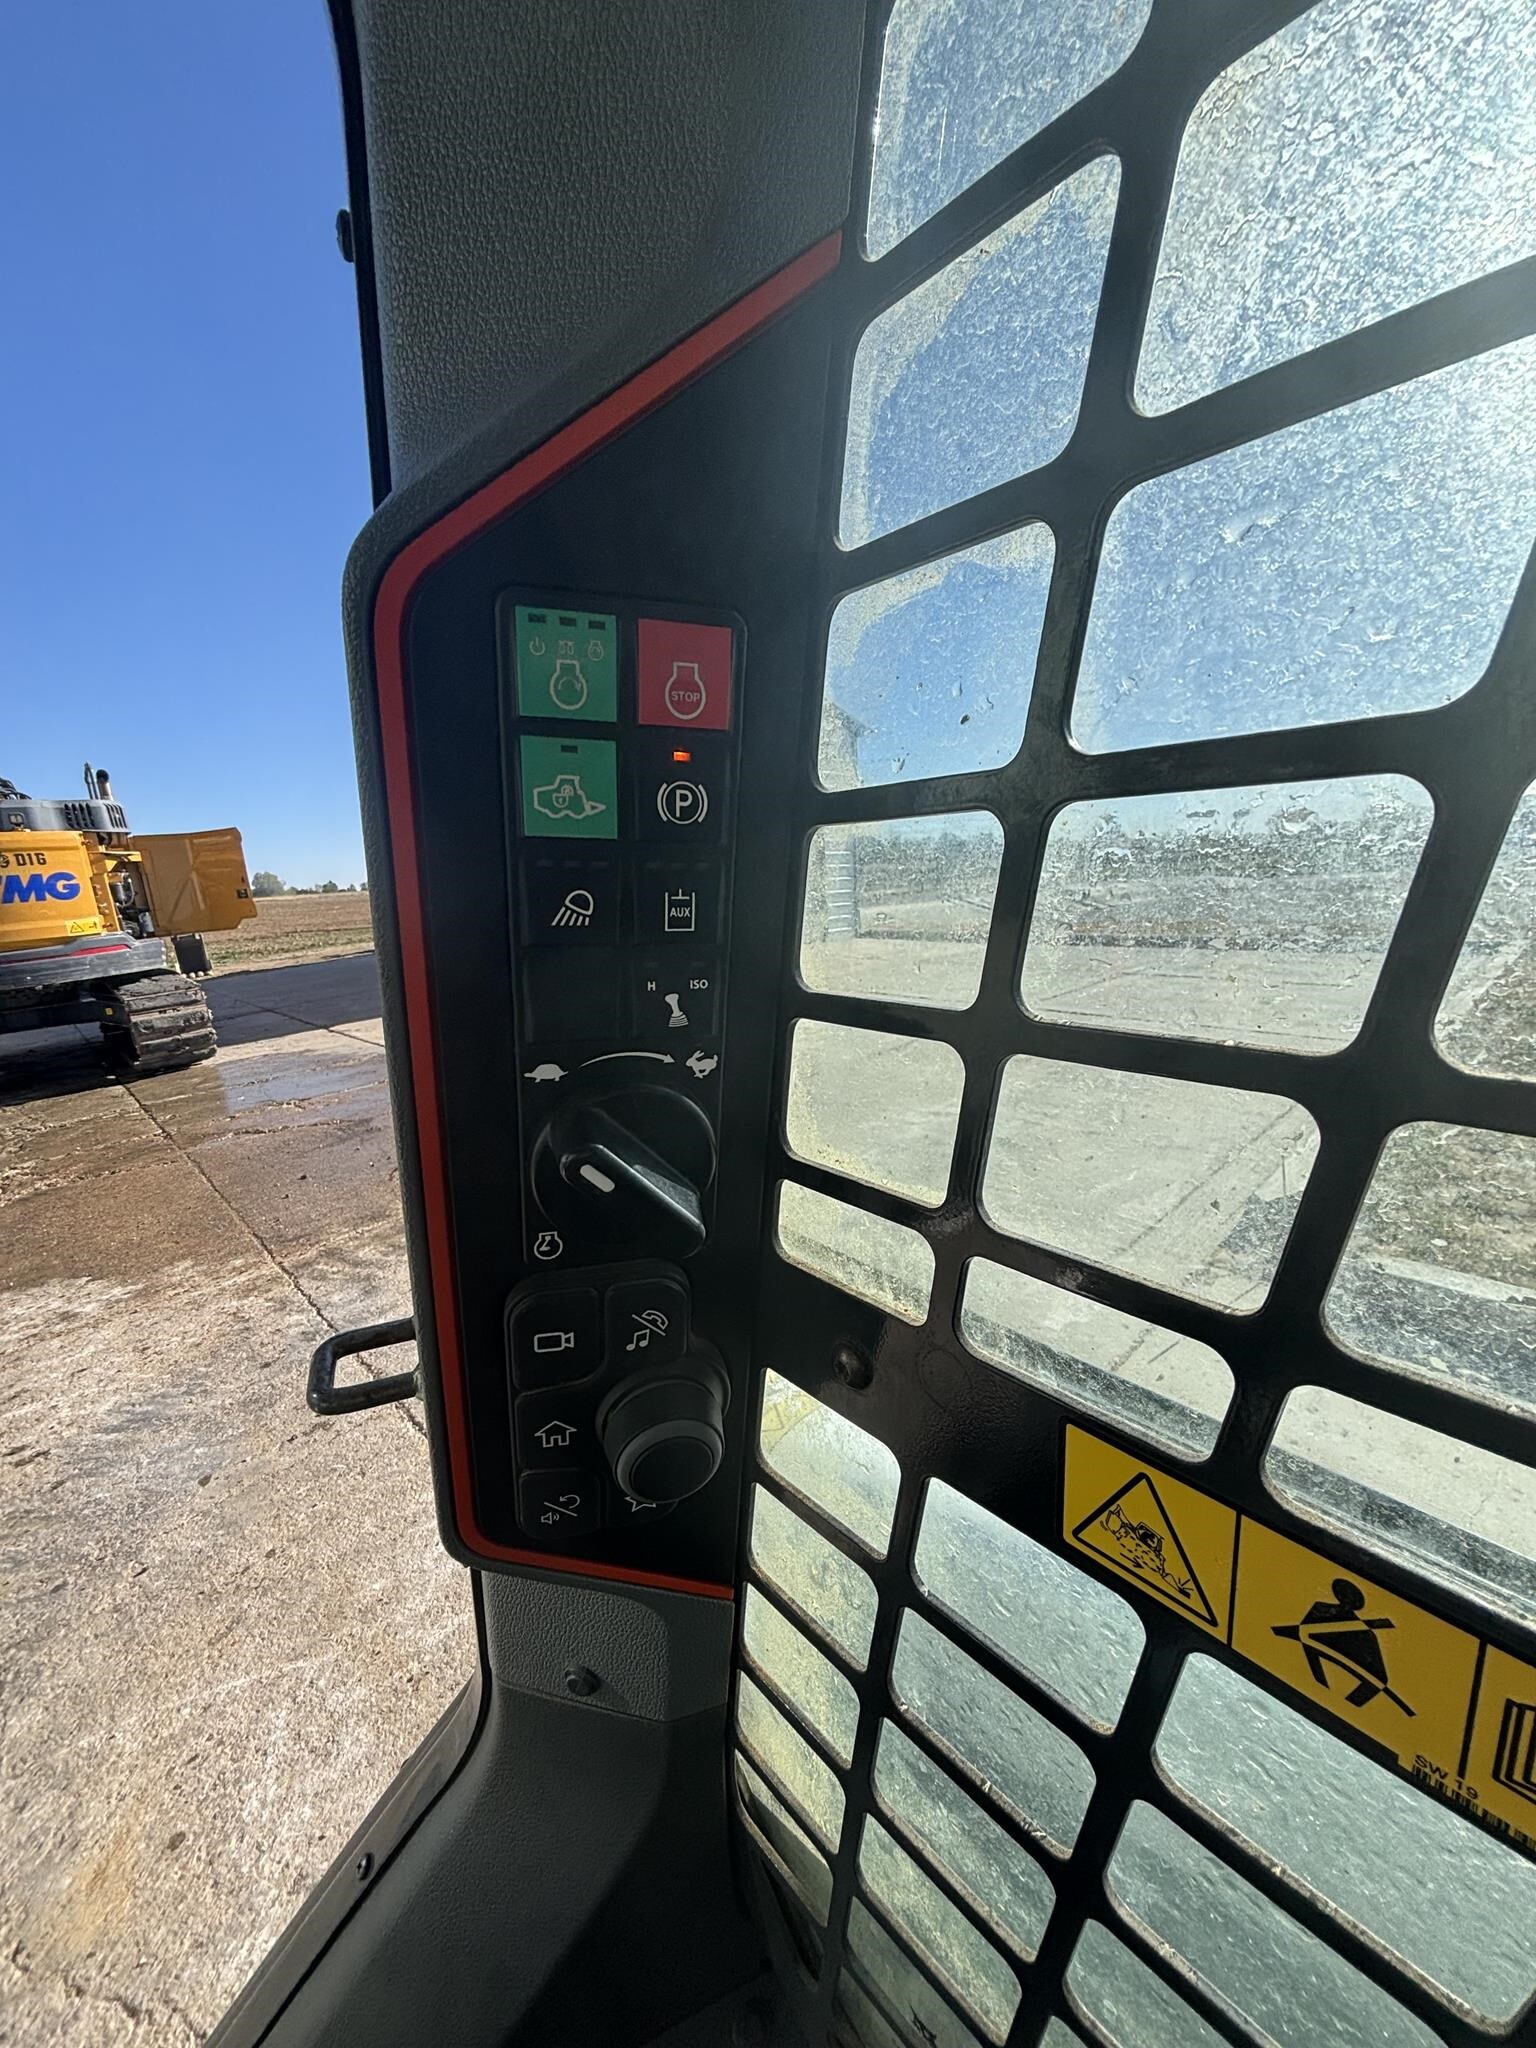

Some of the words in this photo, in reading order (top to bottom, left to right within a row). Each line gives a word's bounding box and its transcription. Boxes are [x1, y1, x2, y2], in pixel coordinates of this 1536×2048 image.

[671, 690, 701, 703] STOP
[0, 871, 81, 904] MG
[669, 907, 691, 918] AUX
[647, 981, 656, 992] H
[689, 979, 709, 990] ISO
[1414, 1754, 1449, 1780] SW
[1455, 1778, 1479, 1800] 19
